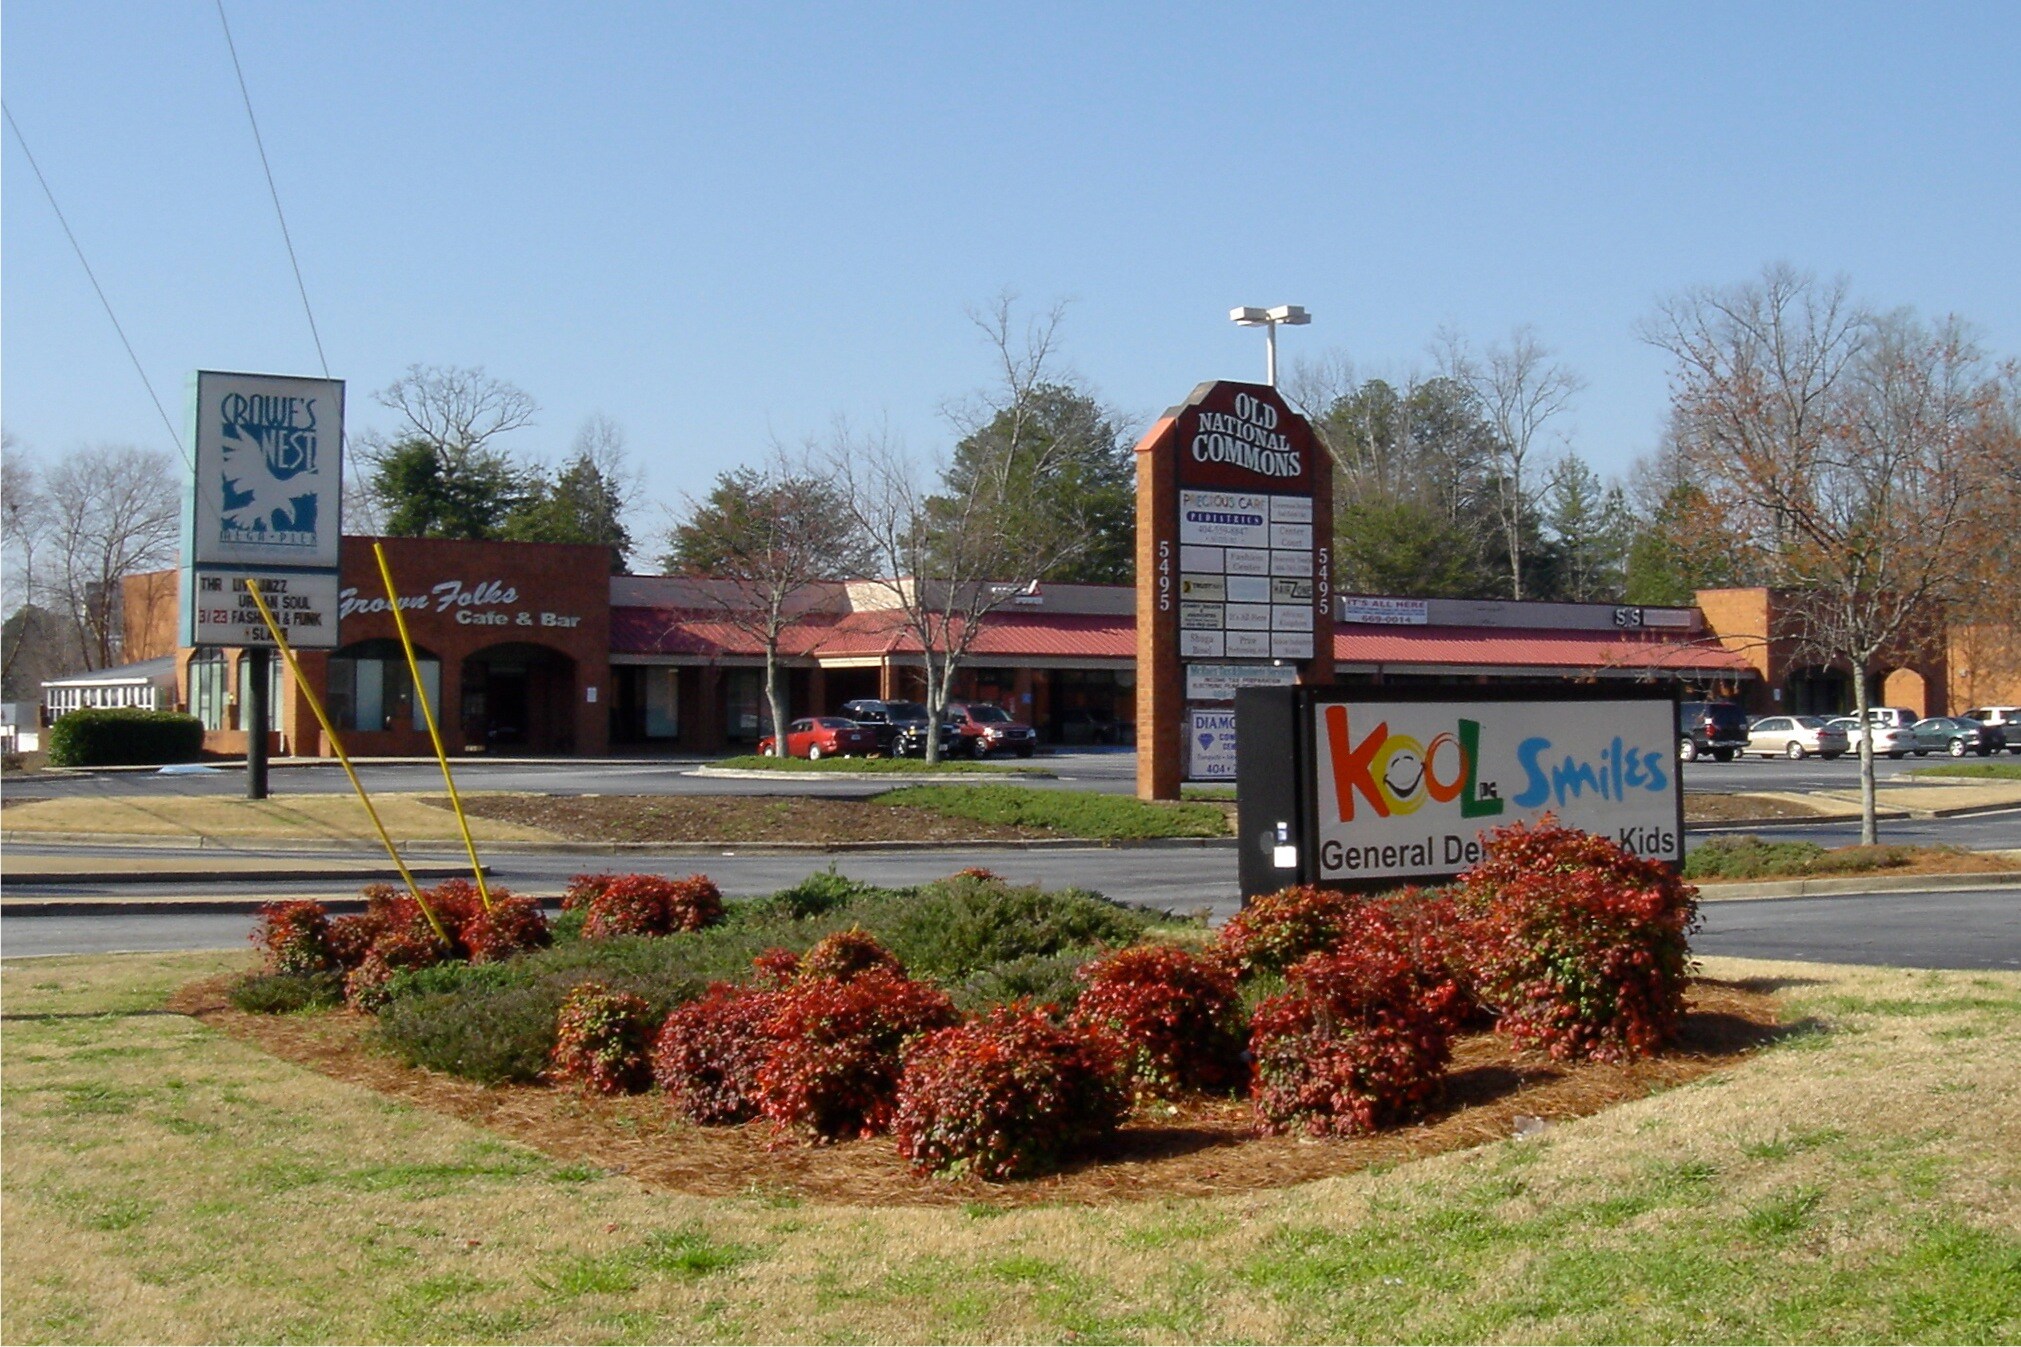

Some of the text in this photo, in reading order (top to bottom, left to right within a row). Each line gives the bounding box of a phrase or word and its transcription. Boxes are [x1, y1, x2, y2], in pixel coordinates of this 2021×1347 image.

[1234, 392, 1278, 430] OLD
[1198, 412, 1290, 451] NATIONAL
[1192, 433, 1301, 477] COMMONS
[1184, 494, 1235, 509] PRECIOUS
[201, 577, 222, 592] THR
[232, 577, 257, 592] LIV
[1159, 540, 1170, 611] 5495
[1318, 548, 1329, 614] 5495
[238, 594, 311, 610] URAN SOUL
[431, 580, 519, 612] Folks
[231, 610, 280, 626] FASHN
[455, 610, 581, 628] Cafe & Bar
[1195, 717, 1235, 729] DIAMO
[1325, 704, 1668, 823] KOOL Smiles
[1320, 836, 1434, 871] General
[1619, 826, 1675, 856] Kids
